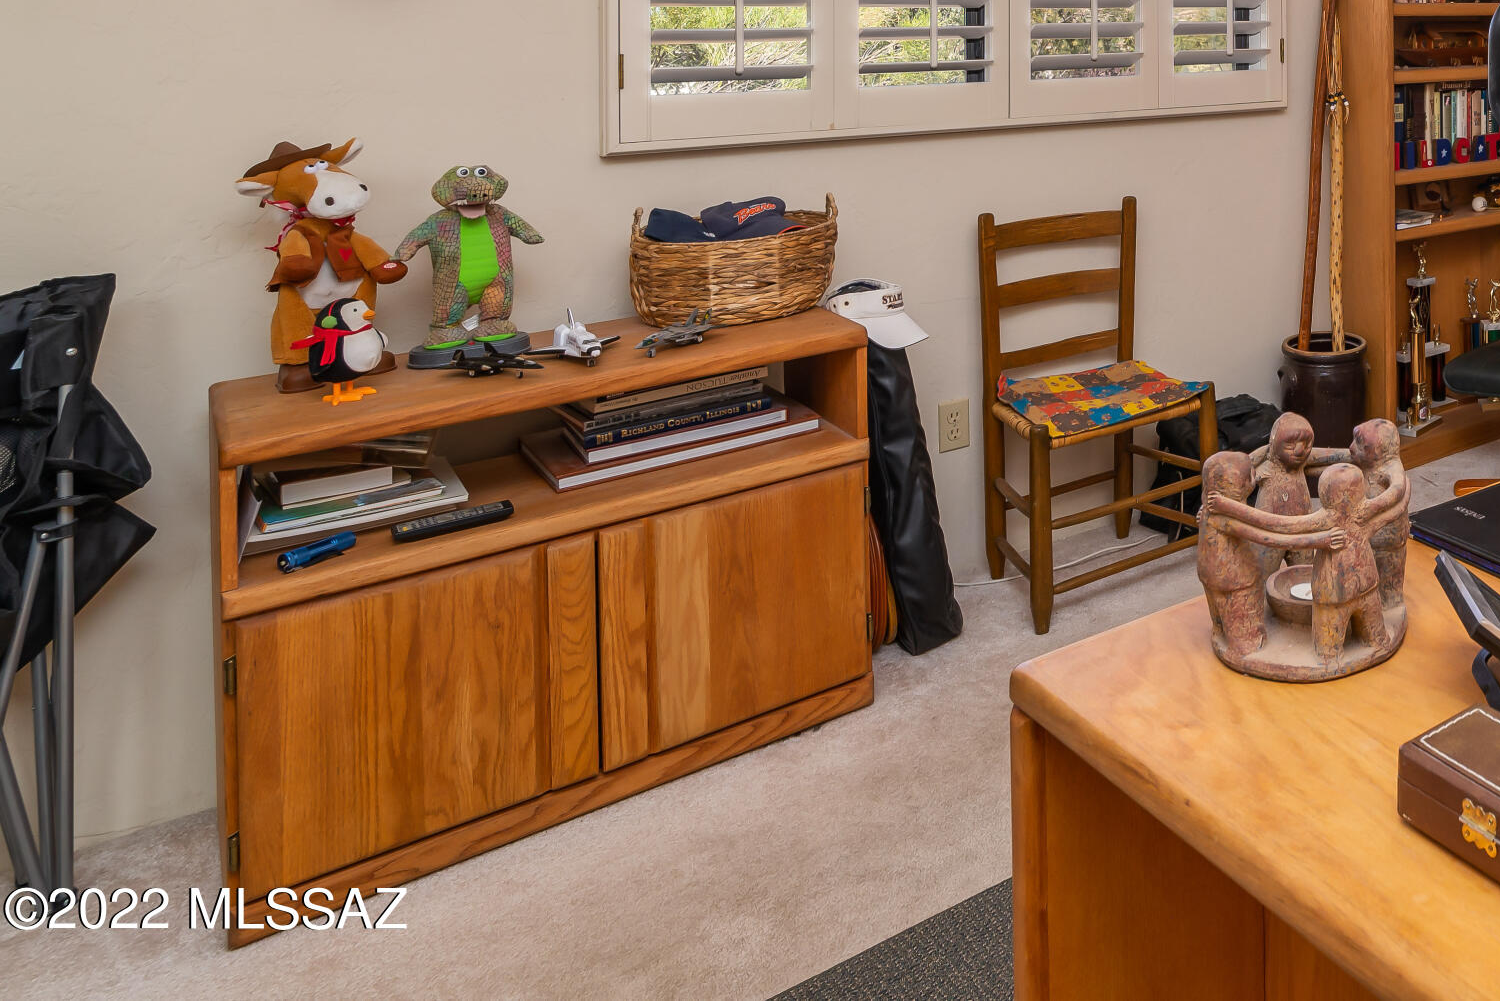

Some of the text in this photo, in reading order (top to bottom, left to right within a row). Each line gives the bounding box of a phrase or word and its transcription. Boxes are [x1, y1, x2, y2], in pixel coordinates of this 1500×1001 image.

[733, 202, 776, 225] Bears
[685, 369, 761, 392] Another TUCSON
[621, 422, 665, 438] RICHLAND
[706, 406, 740, 419] ILLINOIS
